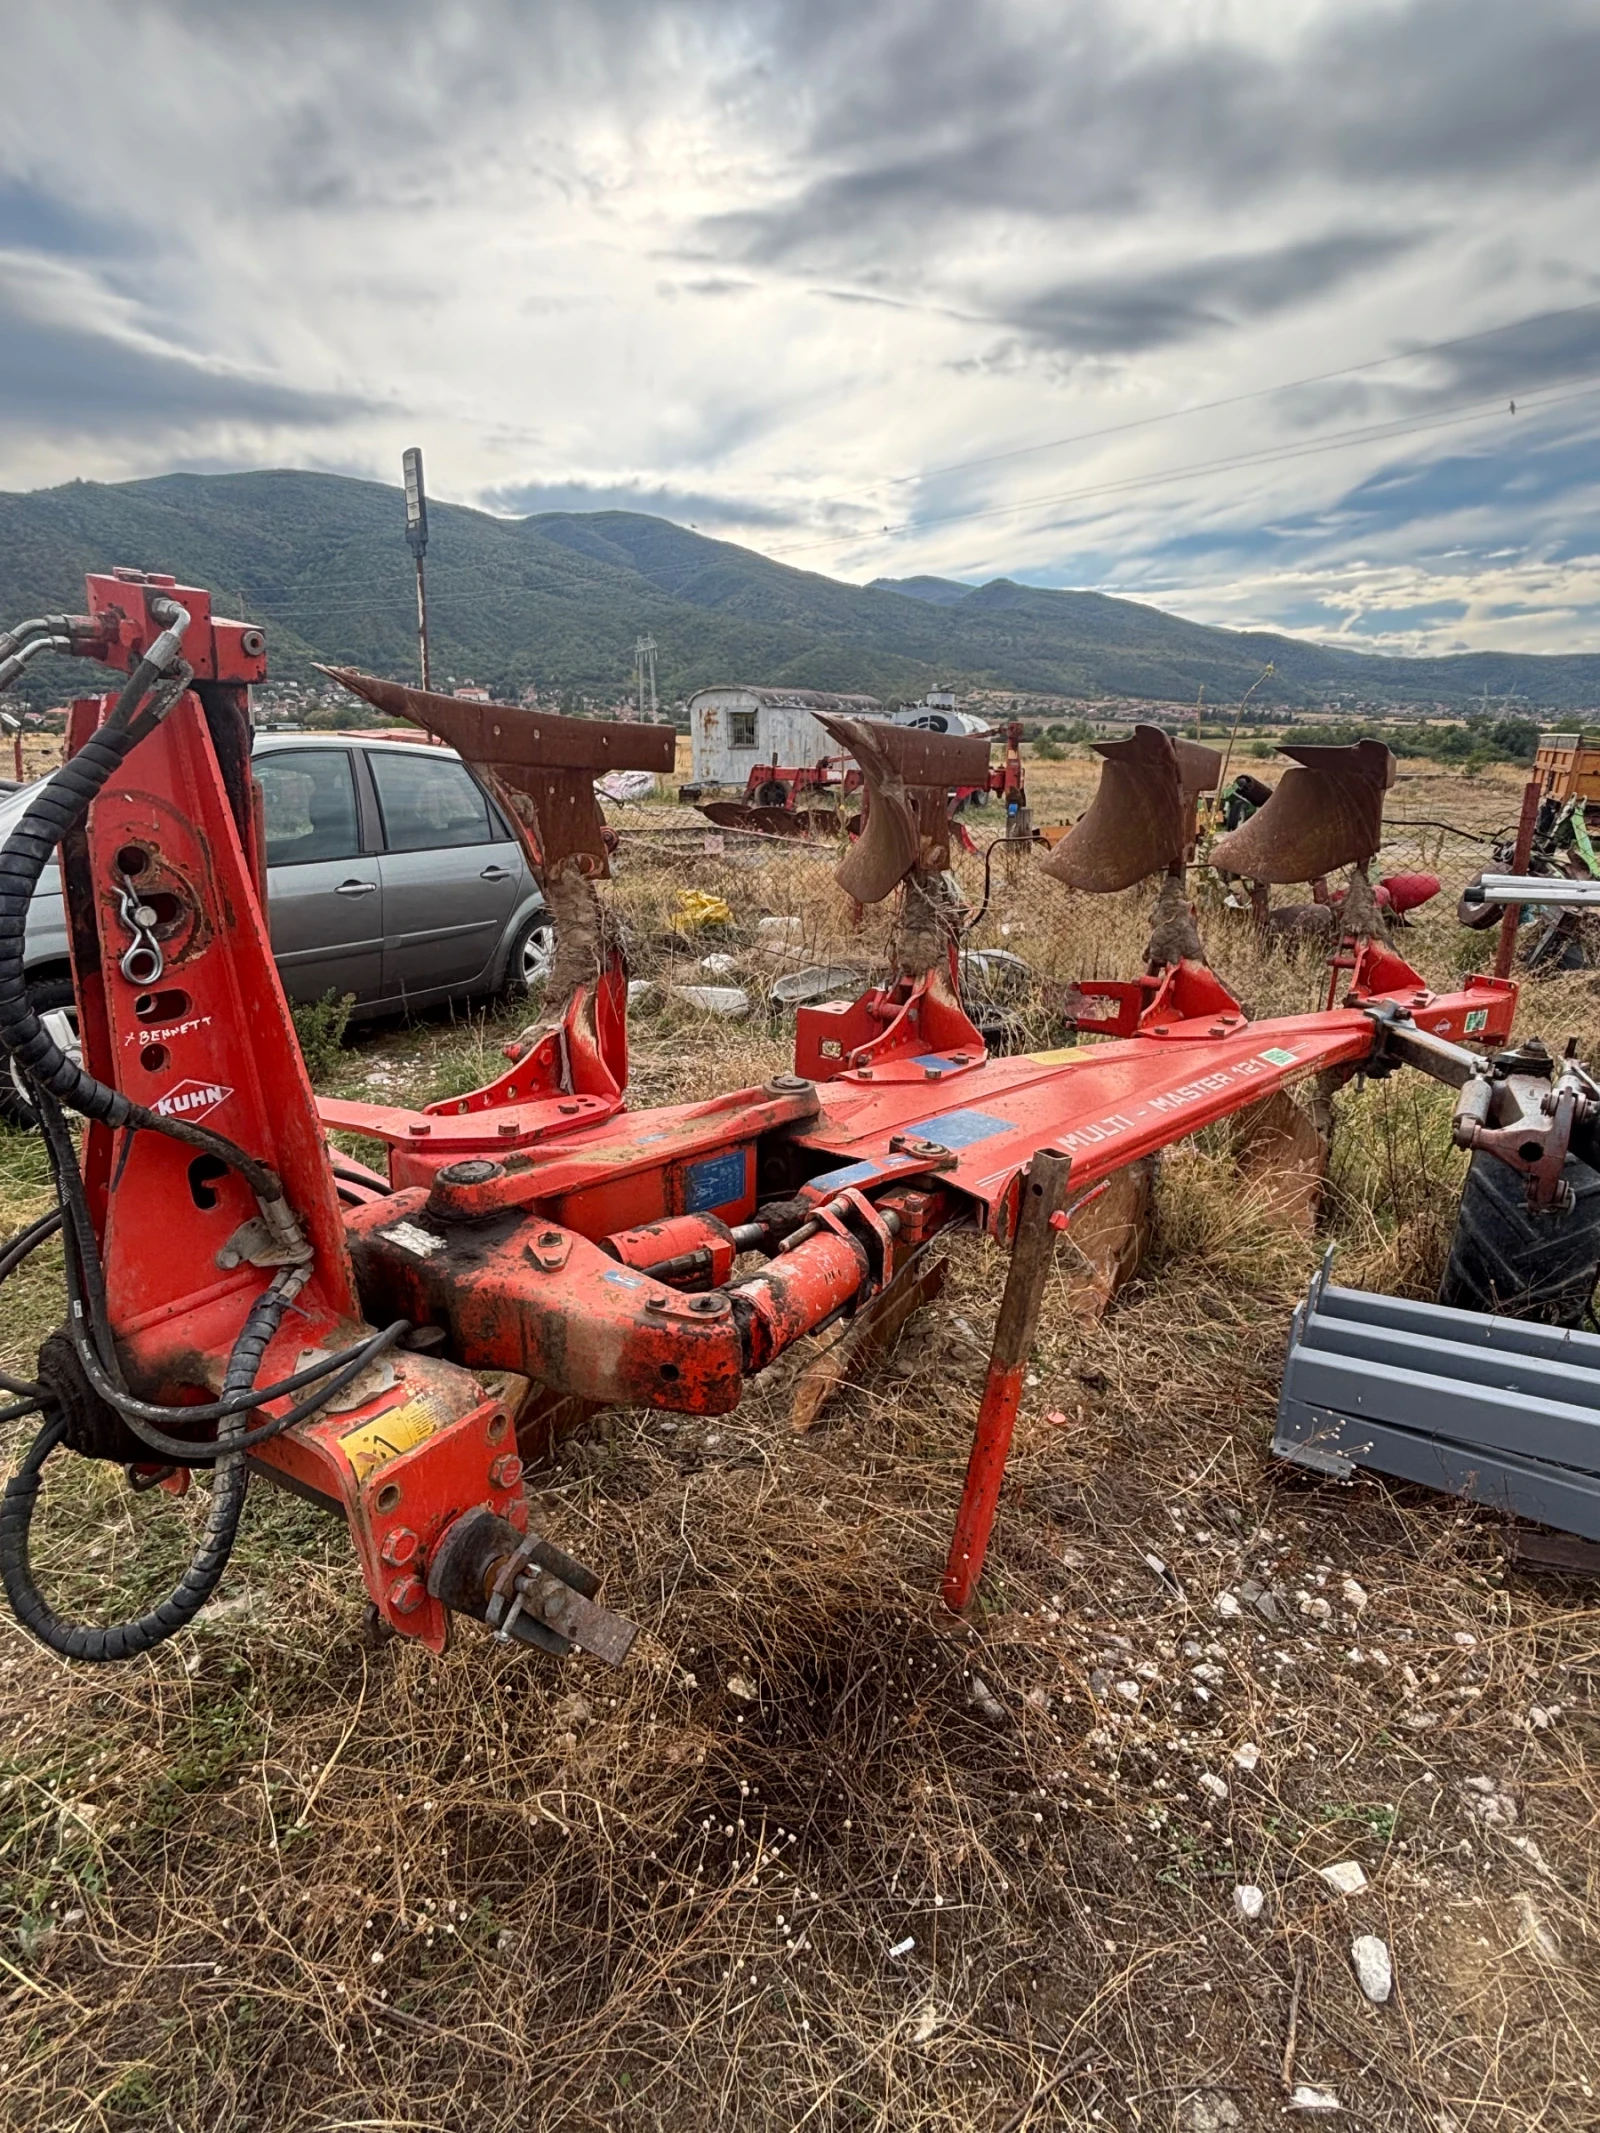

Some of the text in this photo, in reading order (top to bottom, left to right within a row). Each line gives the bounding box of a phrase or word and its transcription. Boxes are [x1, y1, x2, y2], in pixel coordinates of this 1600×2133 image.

[139, 1016, 212, 1045] BENNETT
[157, 1086, 223, 1116] KUHN
[1056, 1114, 1136, 1152] MULTI
[1148, 1072, 1236, 1113] MASTER
[1231, 1058, 1268, 1077] 121
